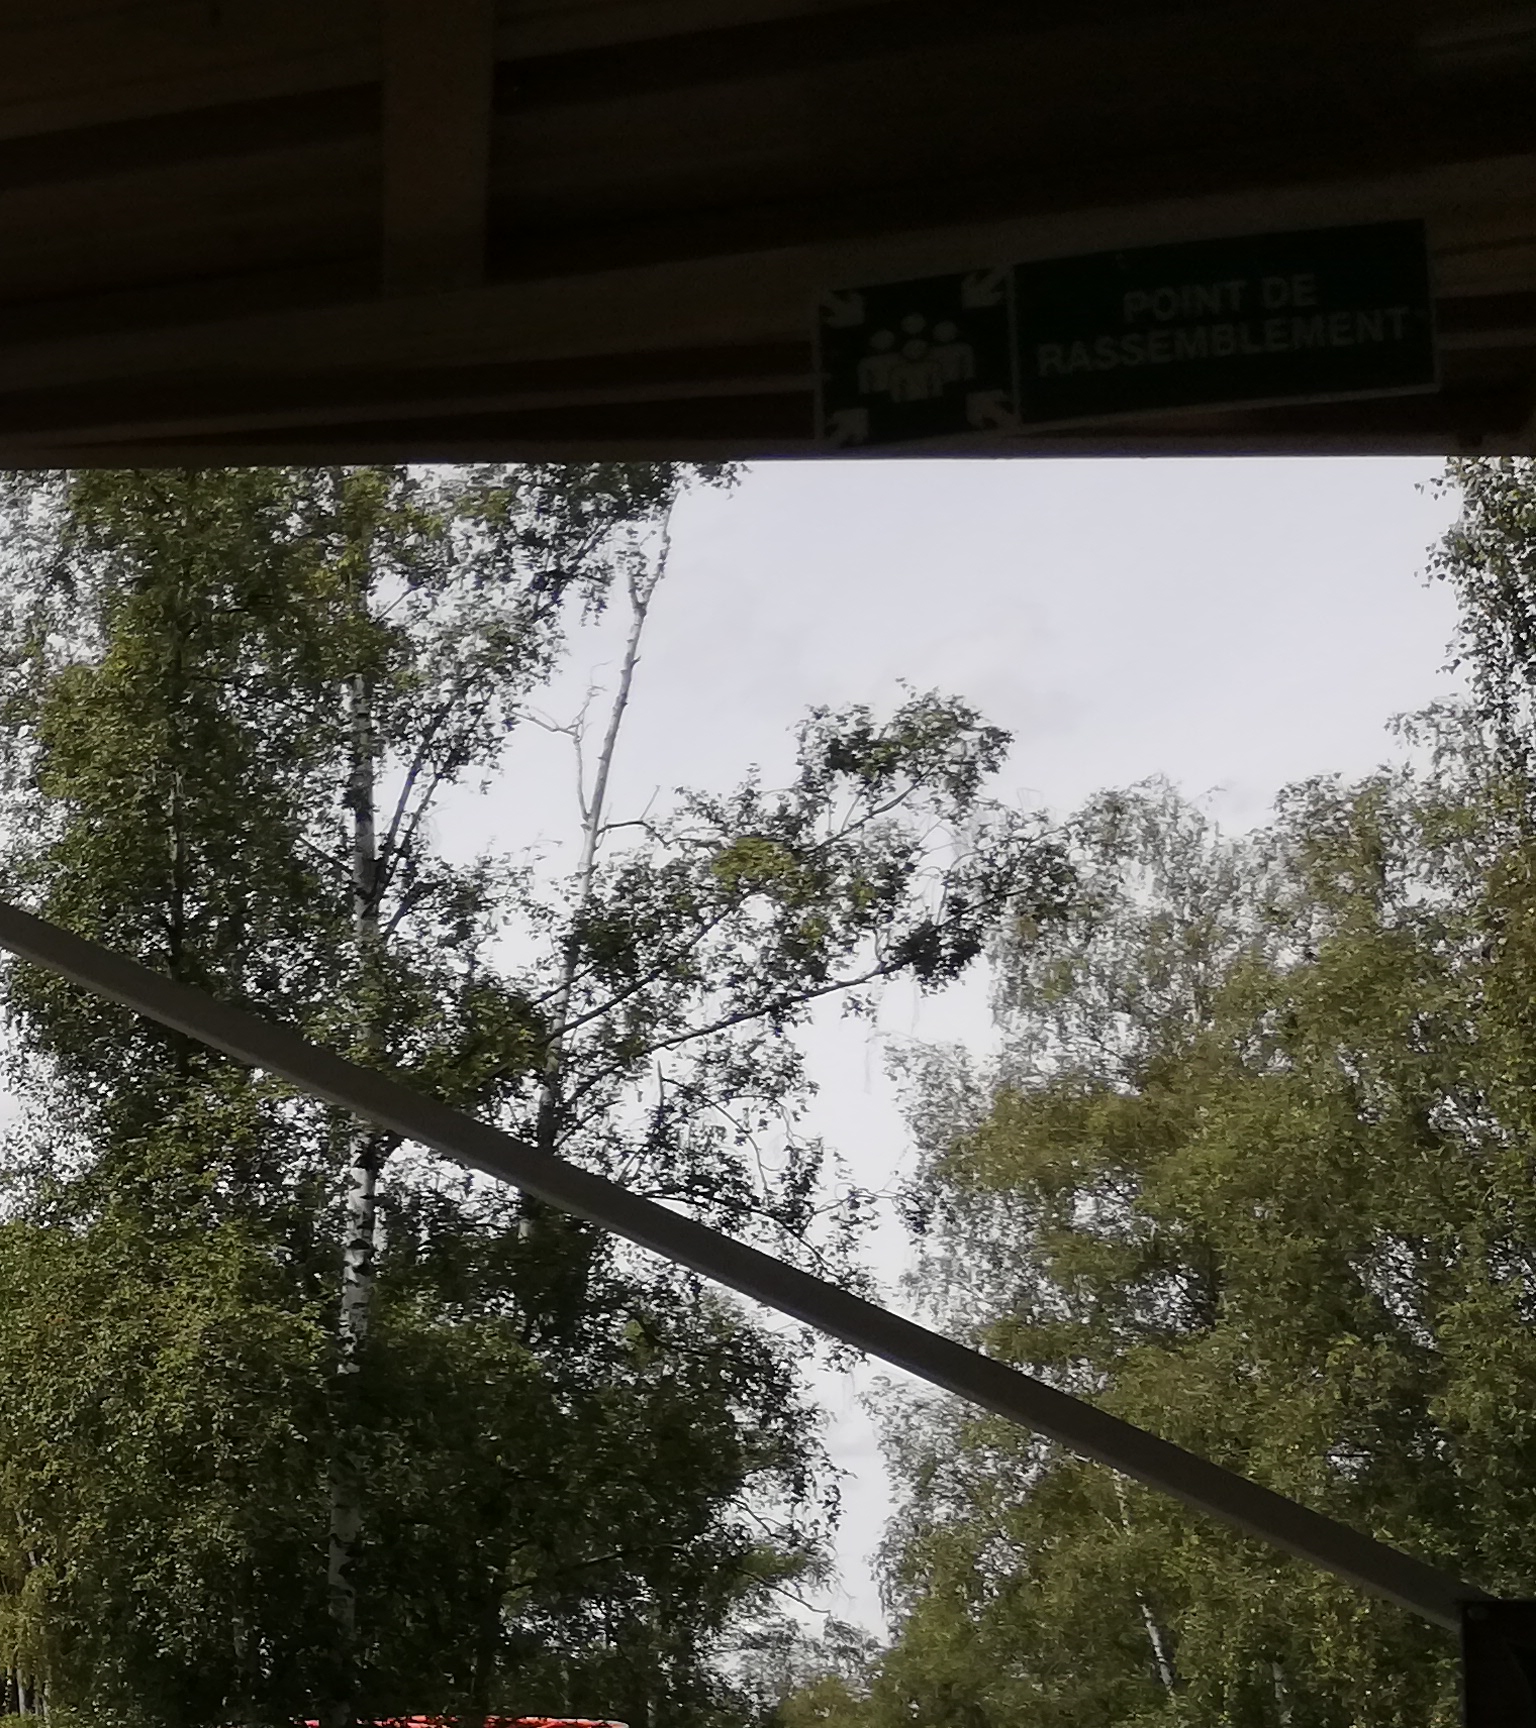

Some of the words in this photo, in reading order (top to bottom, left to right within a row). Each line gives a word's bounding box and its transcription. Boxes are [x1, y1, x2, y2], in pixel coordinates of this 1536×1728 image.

[1122, 278, 1247, 324] POINT
[1260, 272, 1318, 310] DE
[1036, 305, 1409, 378] RASSEMBLEMENT
